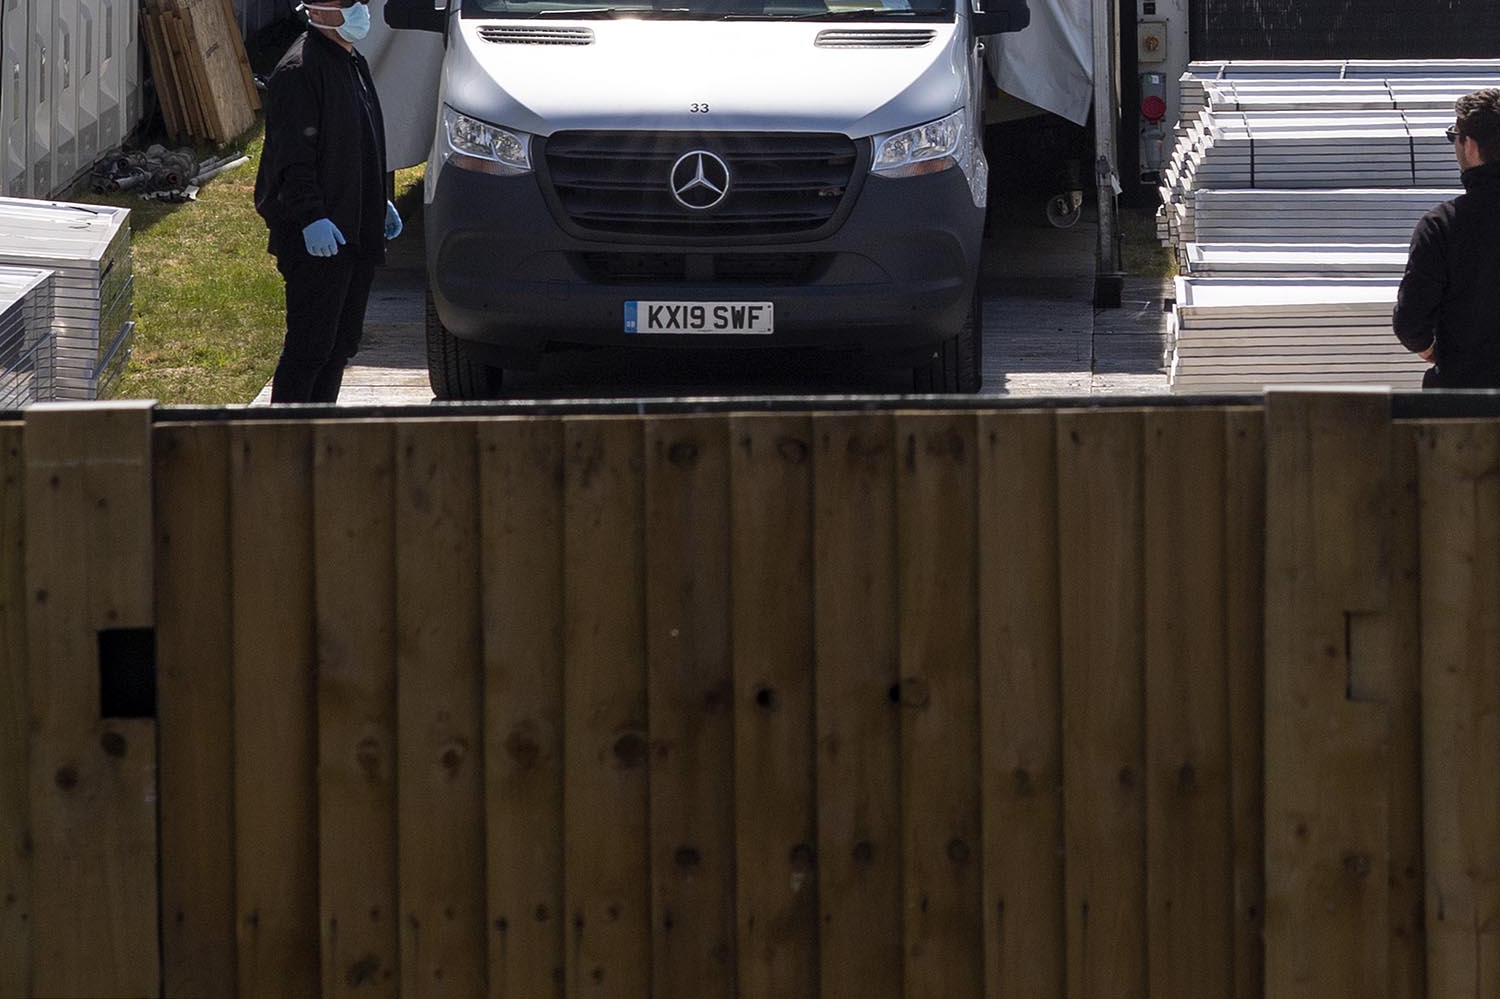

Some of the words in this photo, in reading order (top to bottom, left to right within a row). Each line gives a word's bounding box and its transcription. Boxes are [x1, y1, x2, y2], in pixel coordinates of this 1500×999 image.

[690, 103, 710, 113] 33
[648, 305, 705, 329] KX19
[713, 305, 764, 329] SWF
